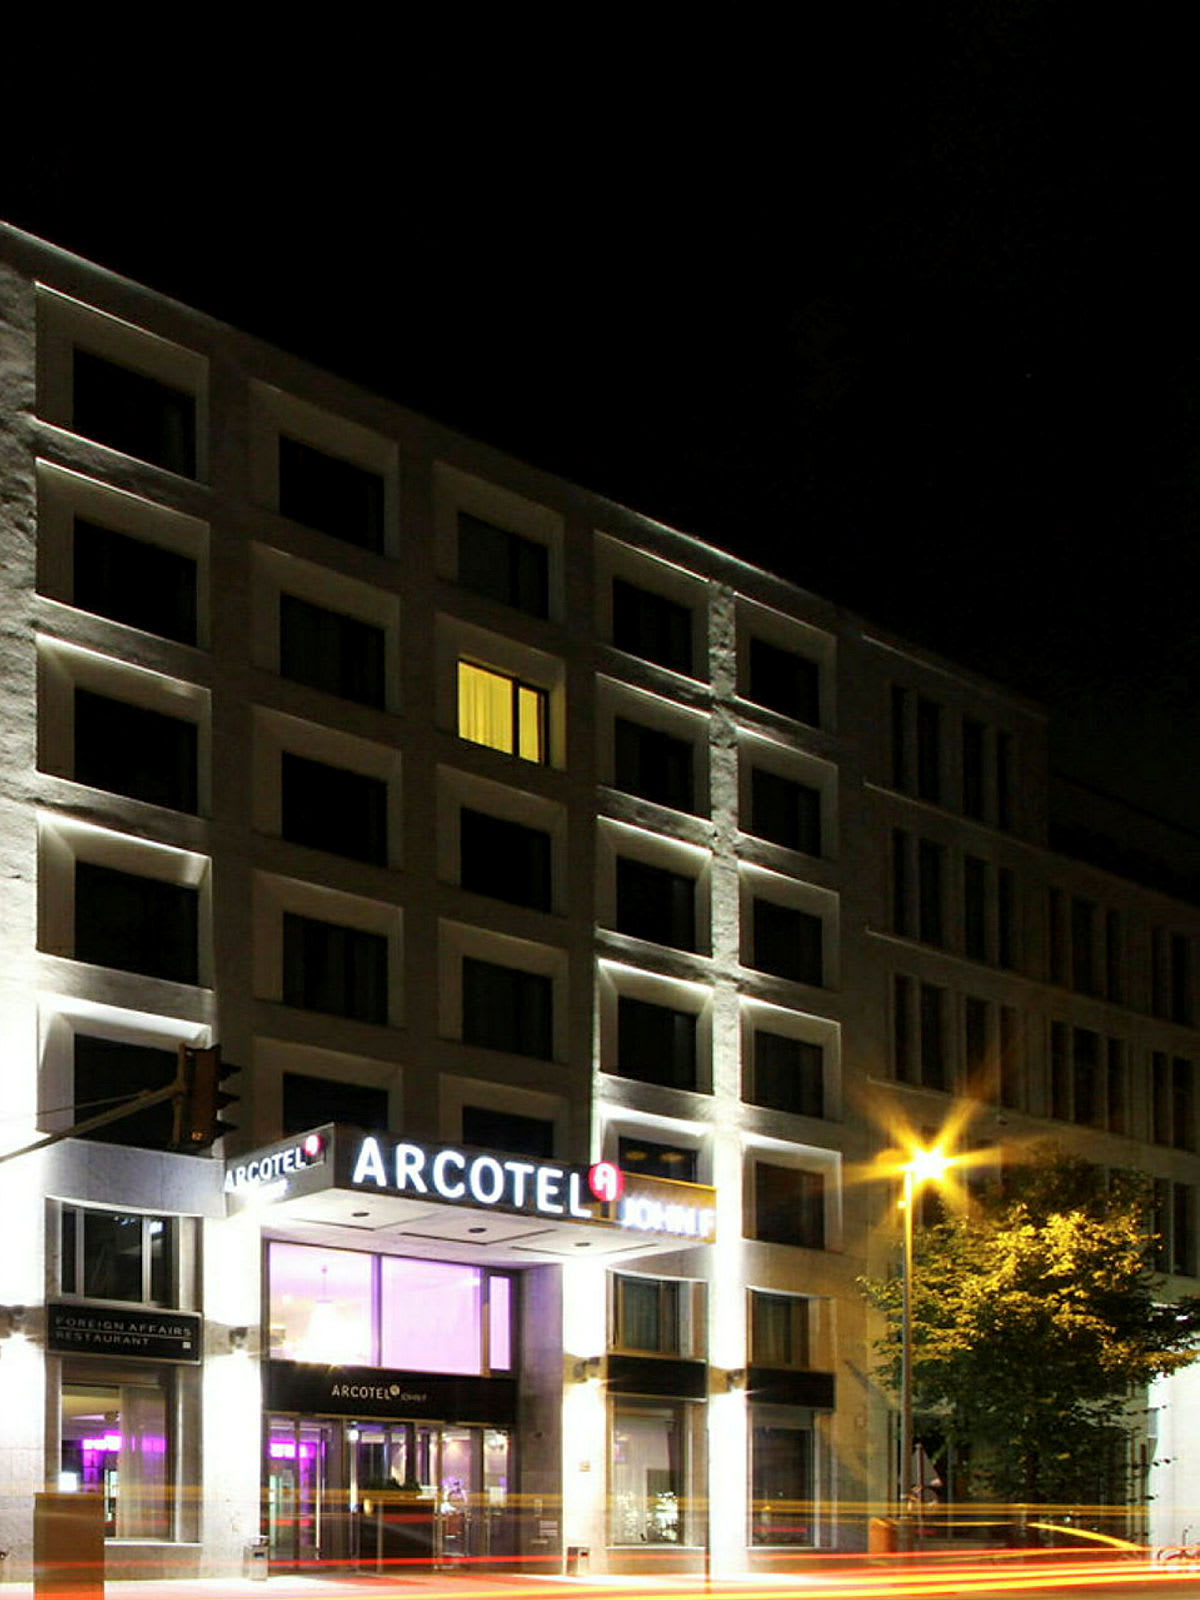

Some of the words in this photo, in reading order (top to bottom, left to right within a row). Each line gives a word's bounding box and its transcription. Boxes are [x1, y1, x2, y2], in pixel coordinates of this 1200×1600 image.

[224, 1145, 307, 1193] ARCOTEL
[352, 1135, 592, 1218] ARCOTEL
[55, 1316, 125, 1330] FOREIGN
[128, 1322, 193, 1336] AFFAIRS
[55, 1330, 150, 1345] RESTAURANT
[331, 1384, 392, 1400] ARCOTEL
